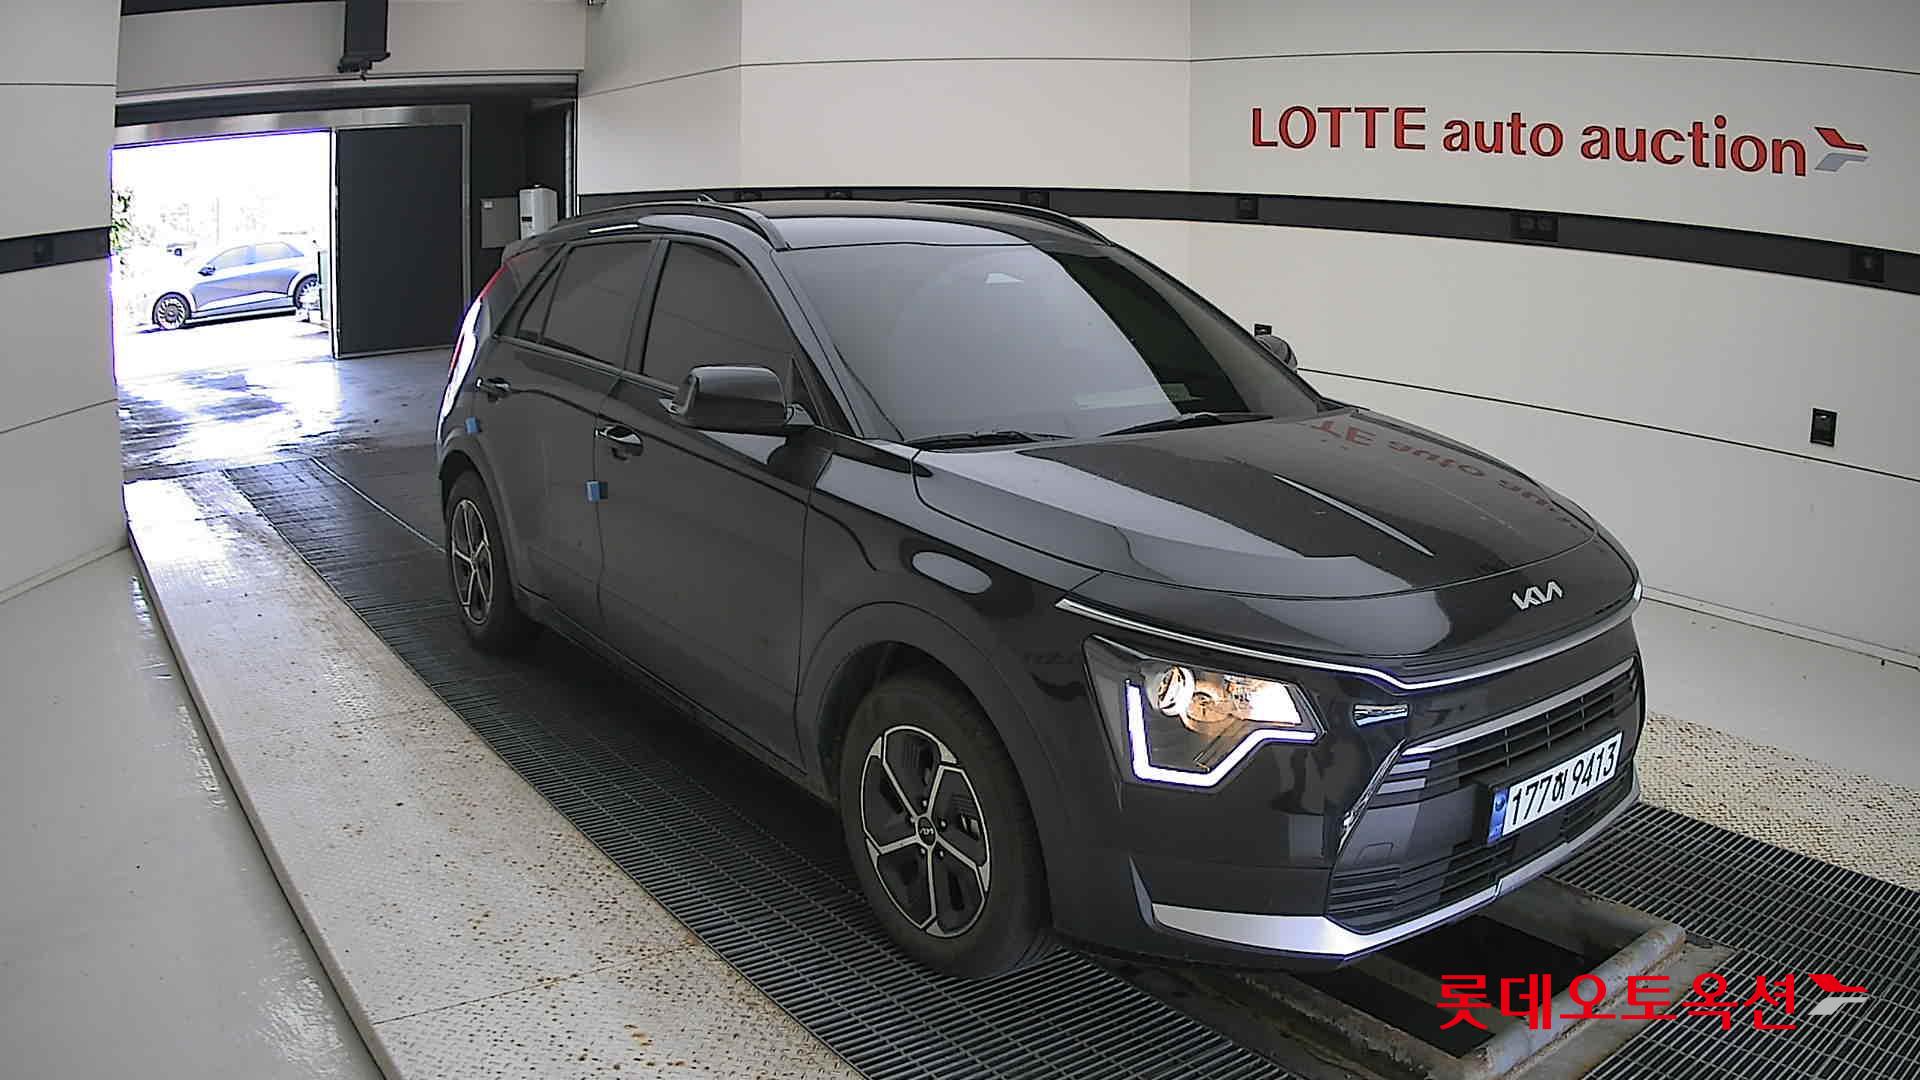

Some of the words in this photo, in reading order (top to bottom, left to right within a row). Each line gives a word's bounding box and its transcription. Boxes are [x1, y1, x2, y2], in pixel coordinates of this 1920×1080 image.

[1251, 106, 1426, 150] LOTTE
[1442, 113, 1565, 157] auto
[1580, 115, 1807, 177] auction
